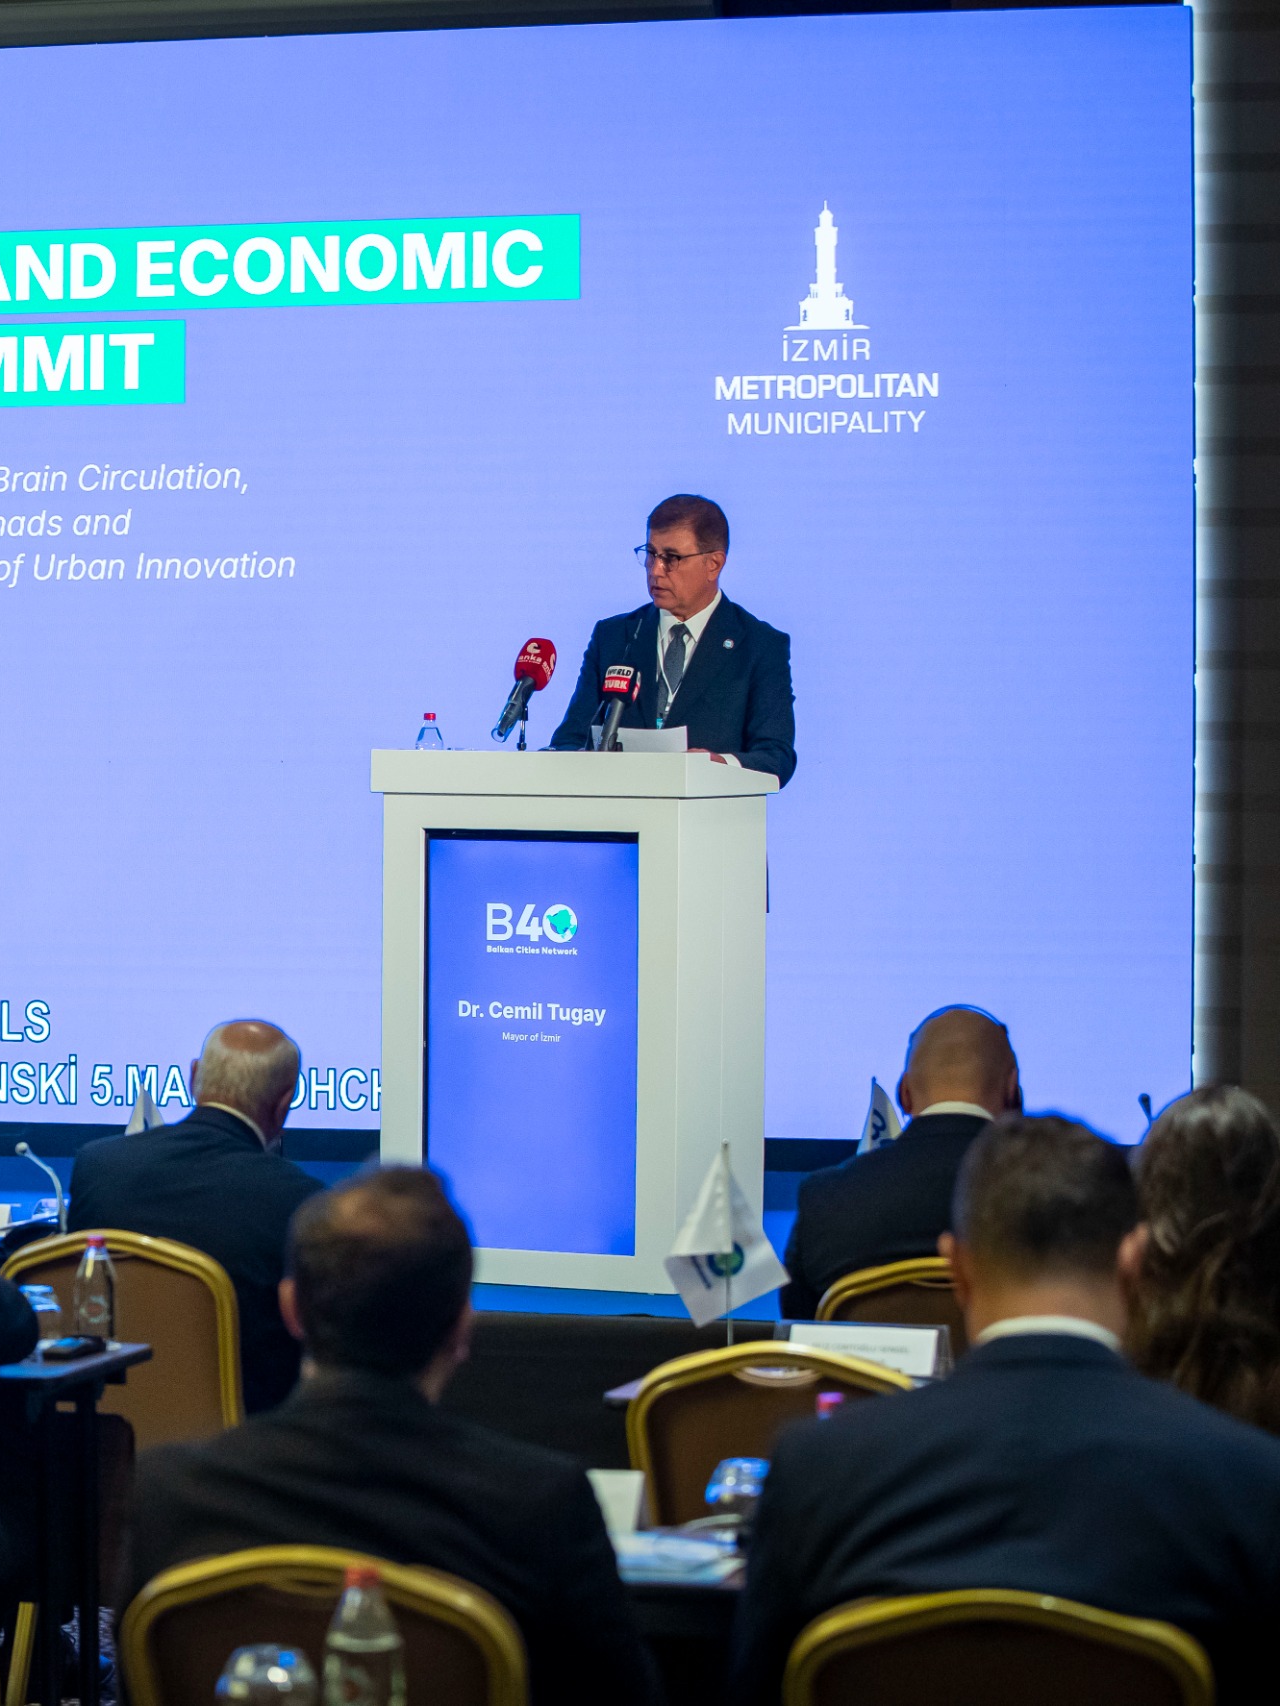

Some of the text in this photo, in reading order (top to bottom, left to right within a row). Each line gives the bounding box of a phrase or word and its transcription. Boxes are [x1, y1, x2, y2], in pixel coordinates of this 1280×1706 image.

[135, 229, 544, 298] ECONOMIC
[782, 333, 871, 362] İZMİR
[715, 372, 939, 401] METROPOLITAN
[727, 410, 926, 435] MUNICIPALITY
[78, 462, 249, 495] Circulation,
[72, 508, 132, 536] and
[33, 553, 126, 581] Urban
[136, 550, 296, 580] Innovation
[486, 902, 578, 943] B40
[486, 945, 578, 956] Balkan Cities Network
[458, 1000, 607, 1027] Dr. Cemil Tugay
[502, 1031, 529, 1043] Mayor
[529, 1032, 539, 1042] of
